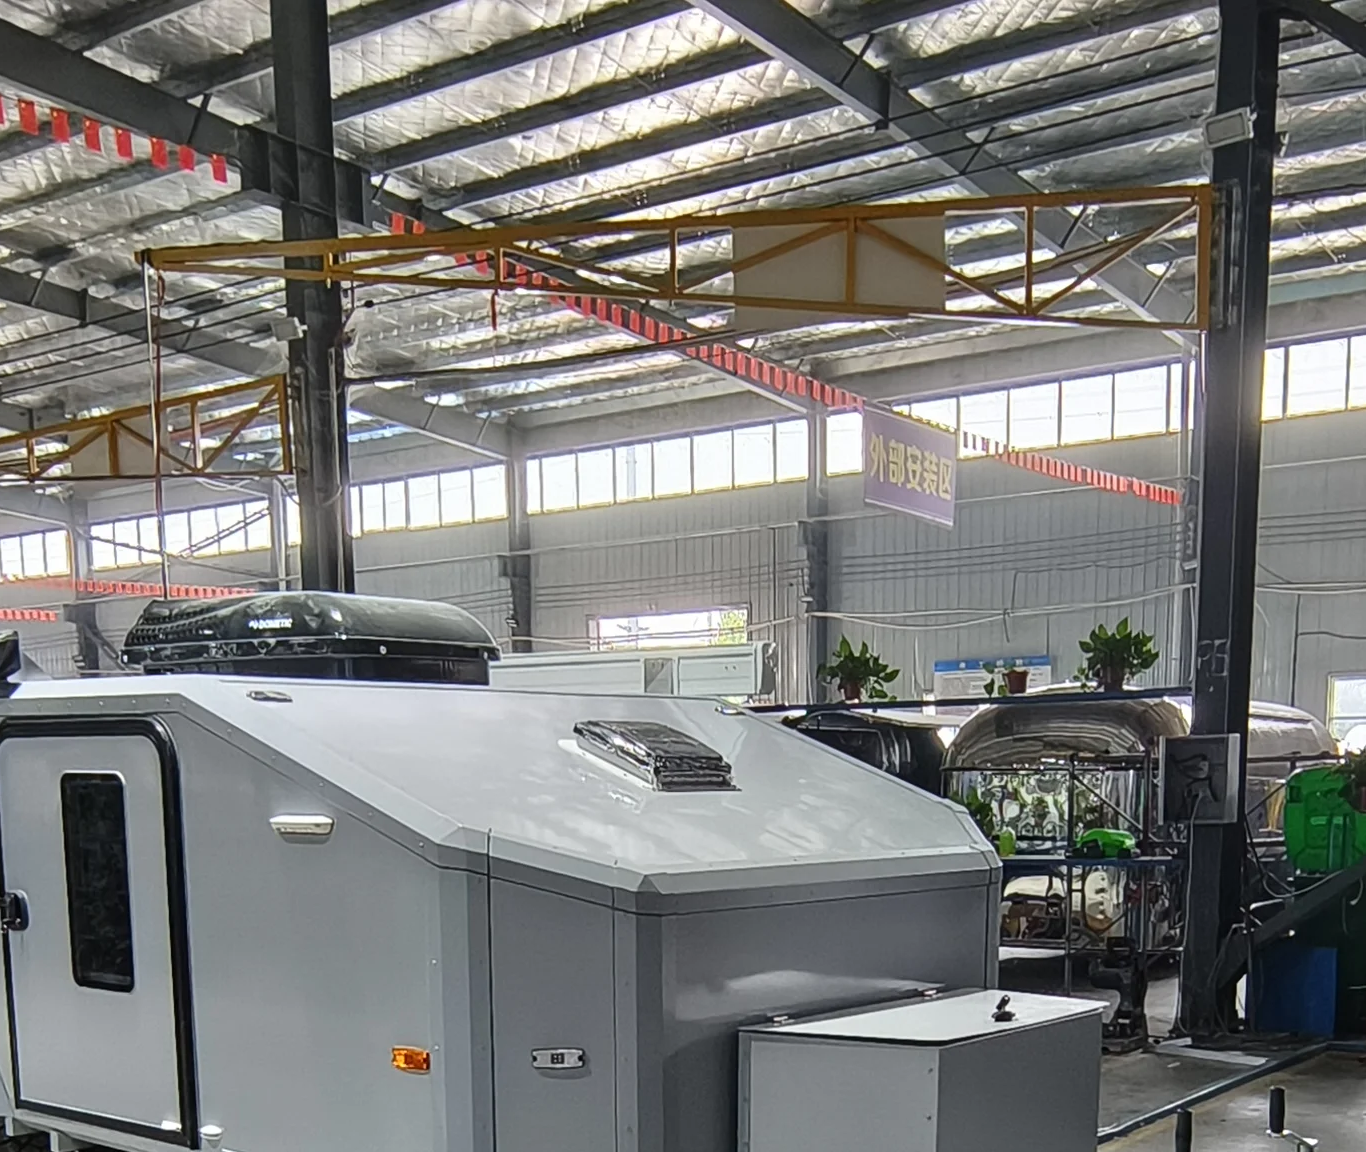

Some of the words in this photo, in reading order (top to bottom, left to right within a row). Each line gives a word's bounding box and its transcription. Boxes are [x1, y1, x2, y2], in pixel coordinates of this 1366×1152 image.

[870, 432, 953, 501] 外部安装区
